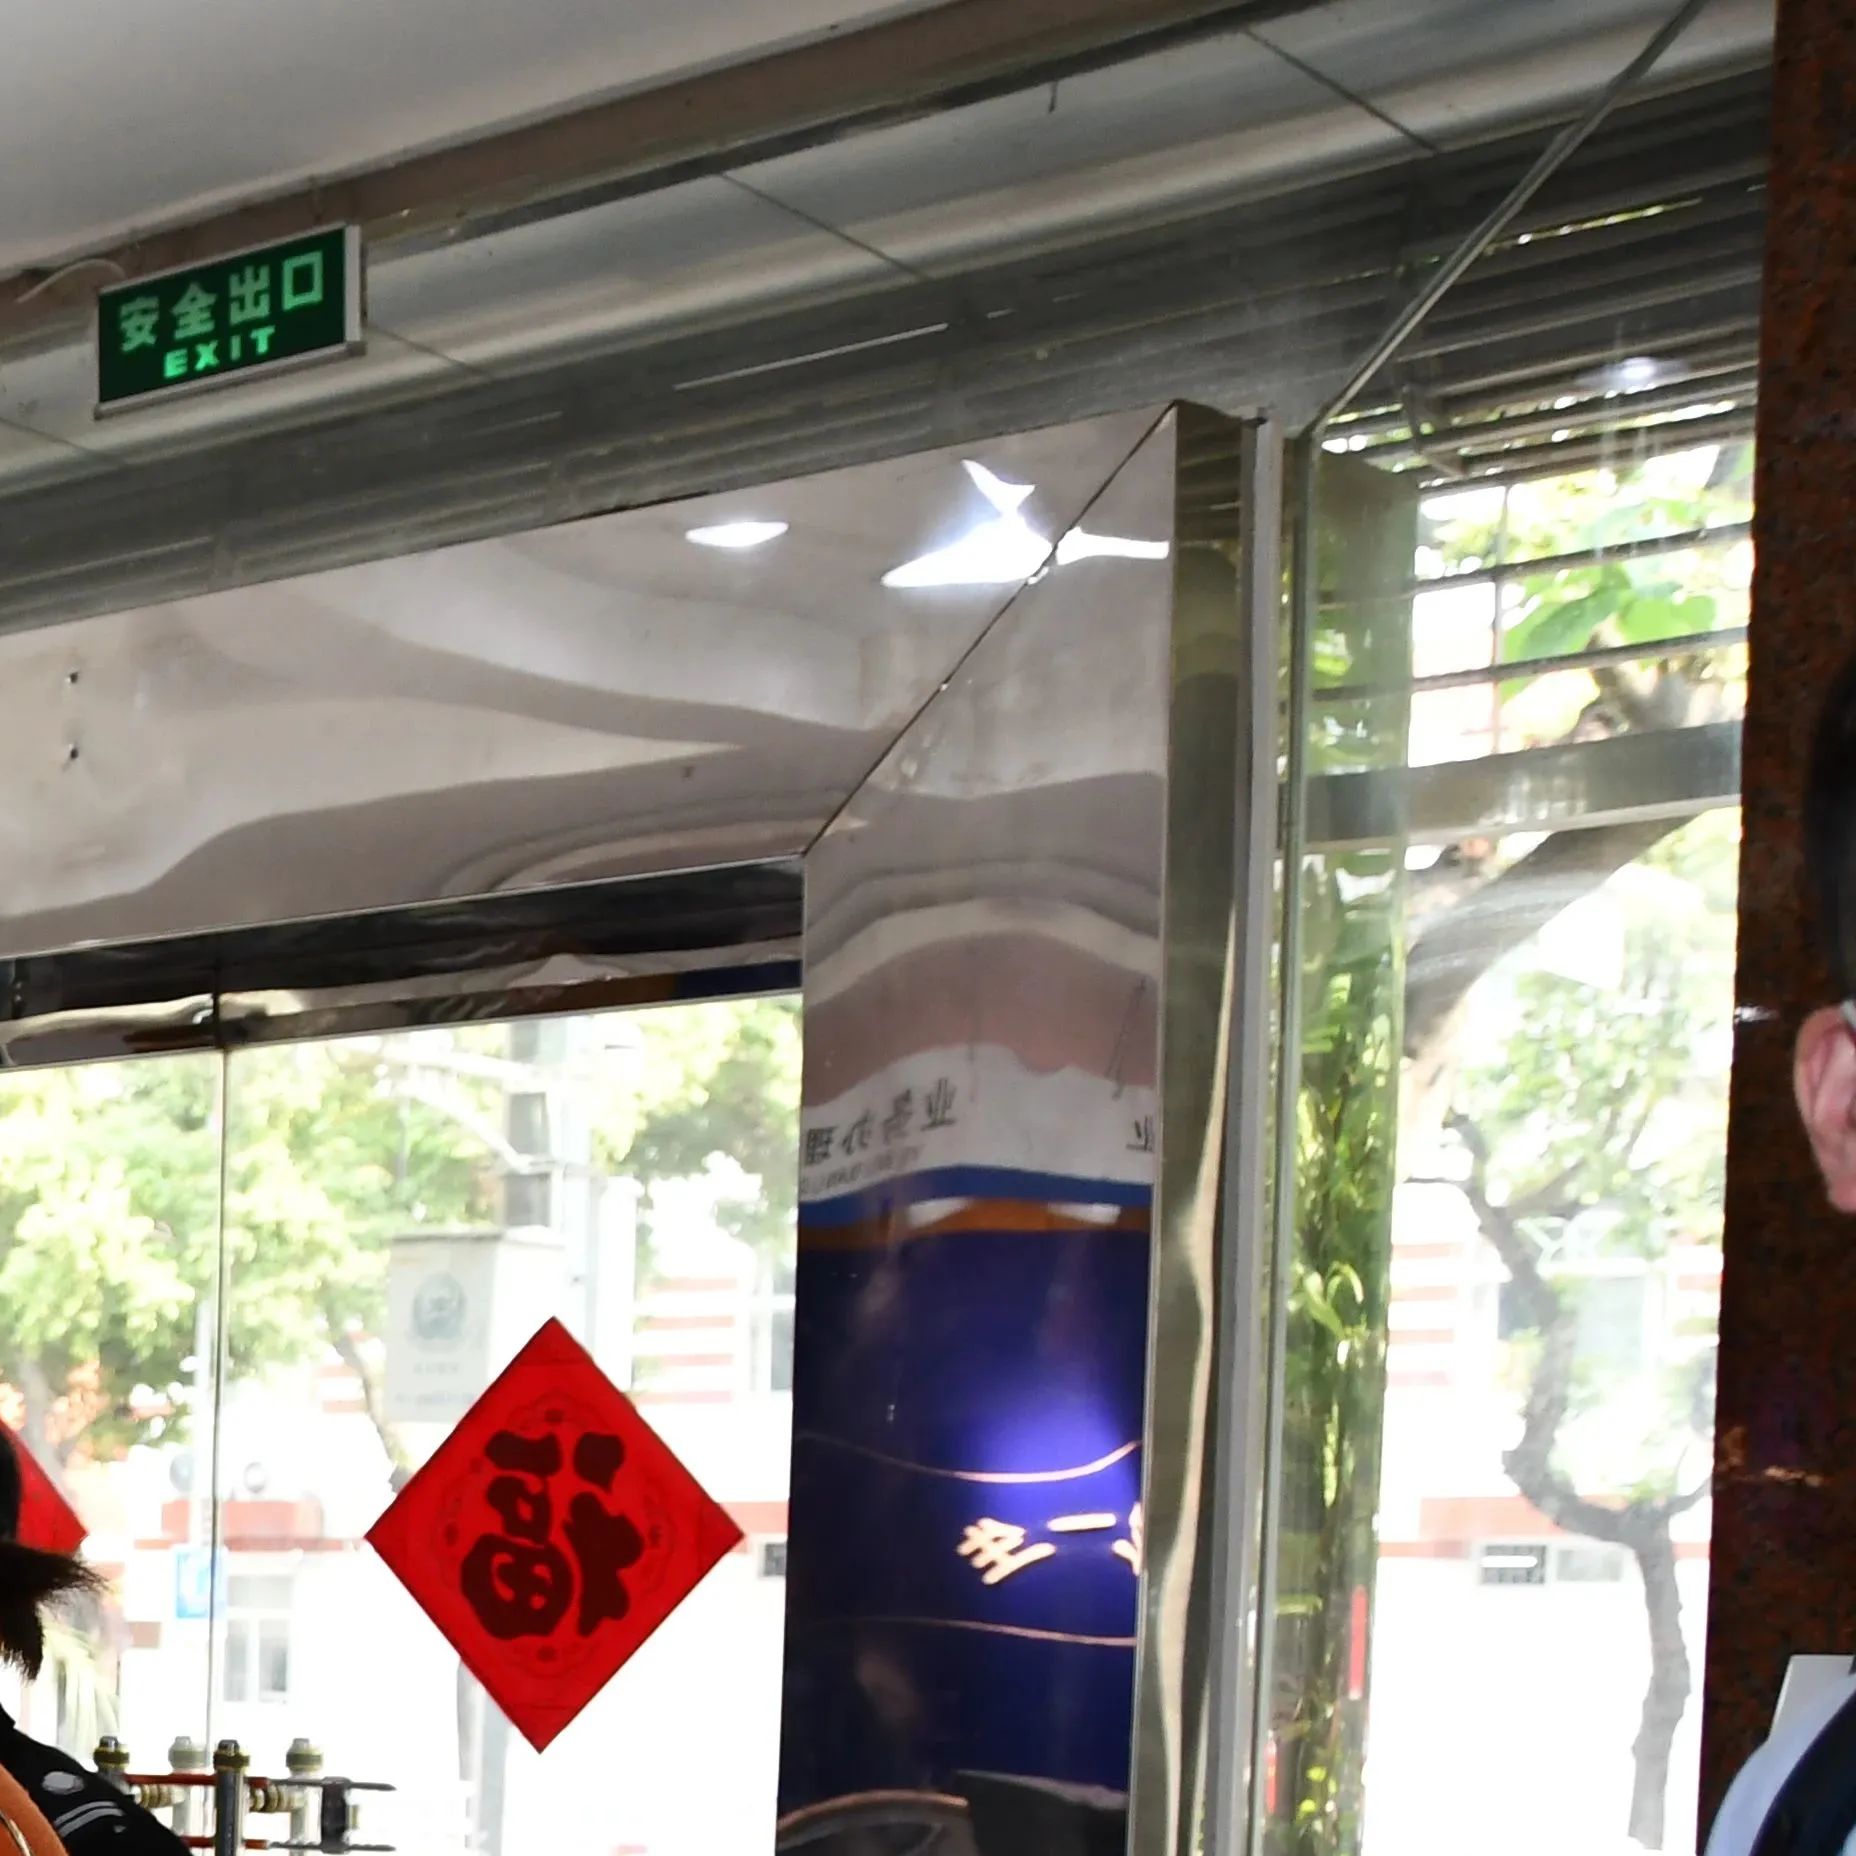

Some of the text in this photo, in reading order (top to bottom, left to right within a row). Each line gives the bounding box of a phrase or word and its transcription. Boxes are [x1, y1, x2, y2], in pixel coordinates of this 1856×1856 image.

[118, 250, 323, 353] 安全出口
[163, 325, 276, 379] EXIT
